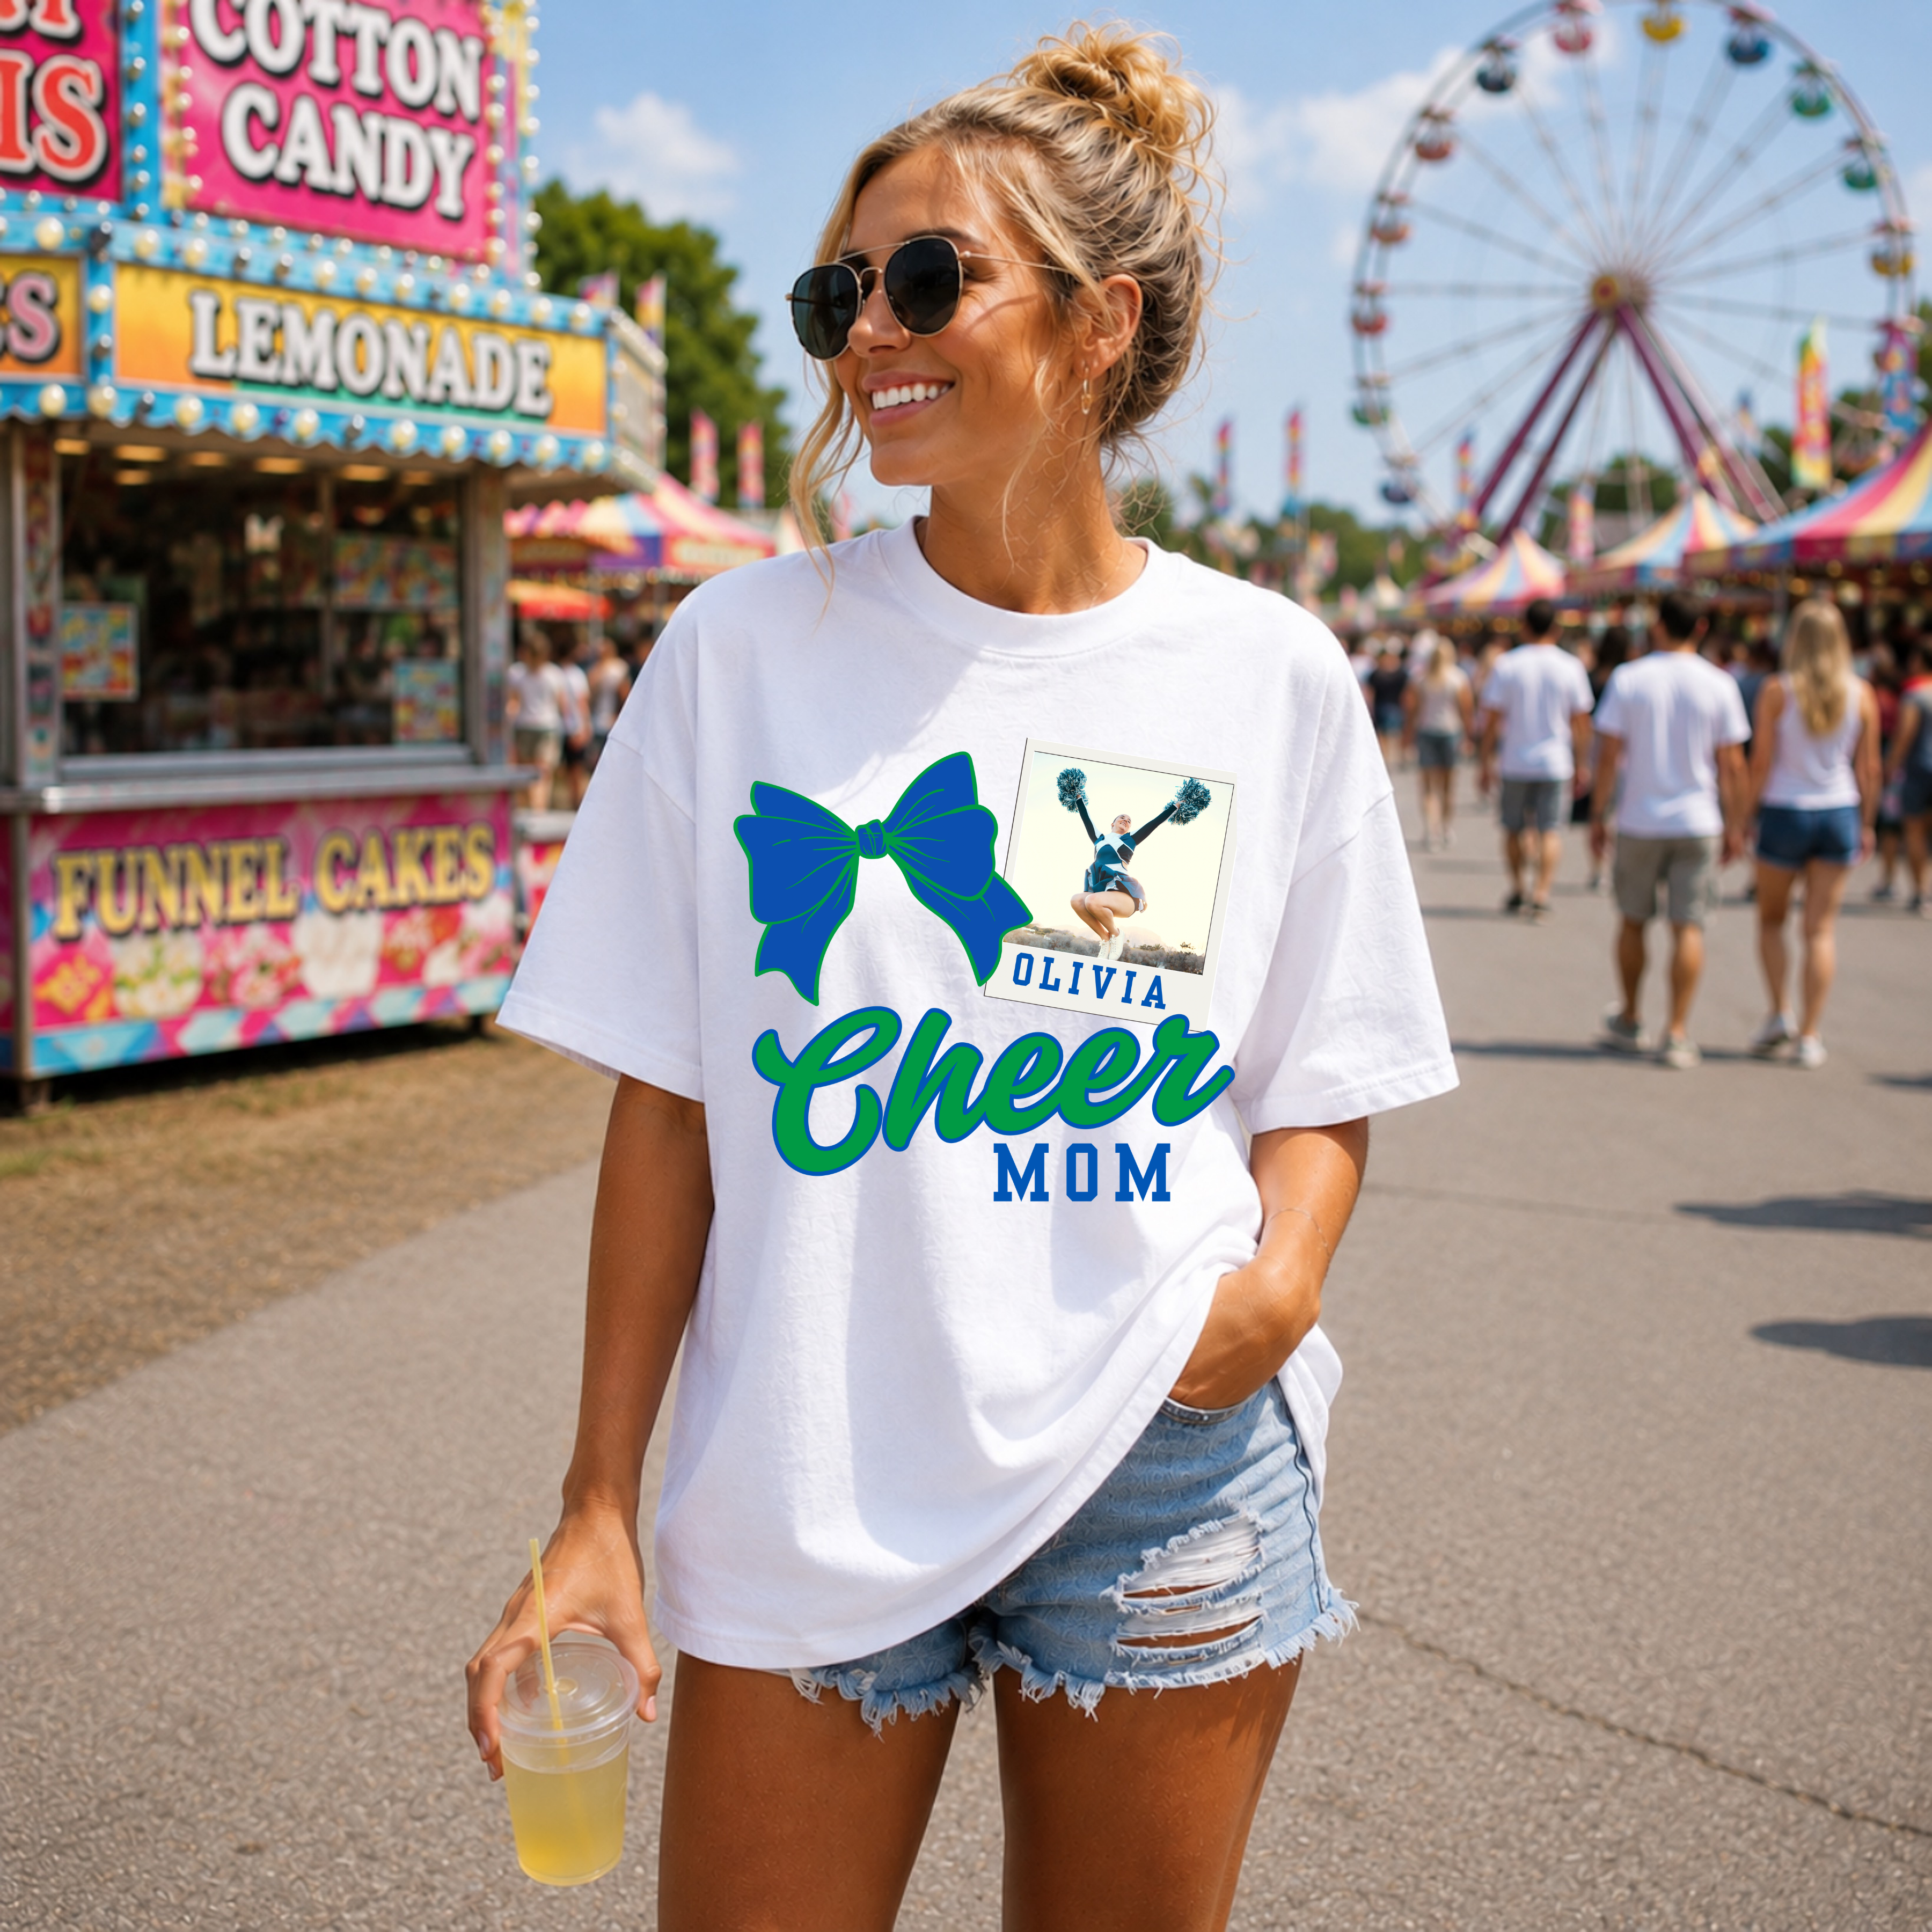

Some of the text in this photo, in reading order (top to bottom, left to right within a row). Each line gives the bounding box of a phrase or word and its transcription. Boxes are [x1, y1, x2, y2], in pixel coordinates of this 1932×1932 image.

[189, 0, 484, 124] COTTON
[223, 82, 477, 219] CANDY
[189, 290, 552, 417] LEMONADE
[52, 824, 495, 940] FUNNEL CAKES
[1012, 952, 1167, 1010] OLIVIA
[752, 1006, 1235, 1176] Cheer
[993, 1143, 1170, 1202] MOM
